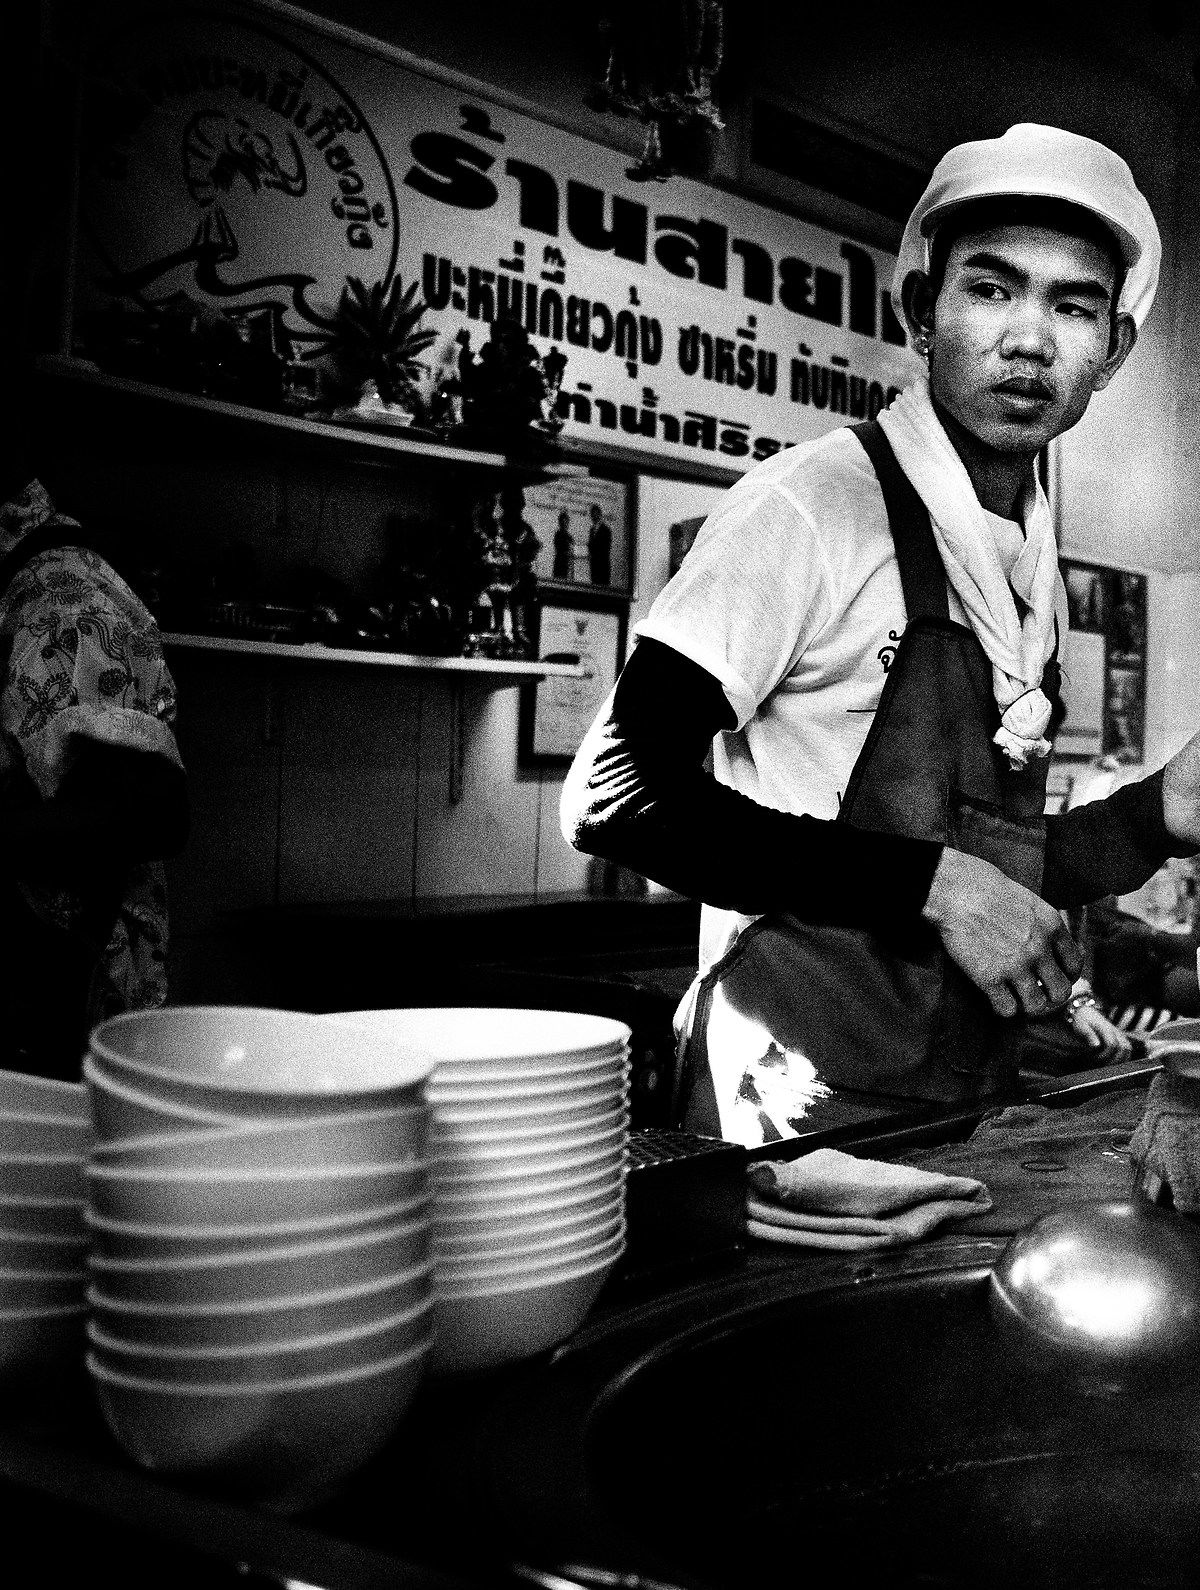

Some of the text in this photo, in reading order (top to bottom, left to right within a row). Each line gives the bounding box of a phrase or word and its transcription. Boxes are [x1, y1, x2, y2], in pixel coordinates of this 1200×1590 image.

[554, 382, 798, 462] ท่าน้ำศิริร
[790, 342, 902, 422] ทับทิมก
